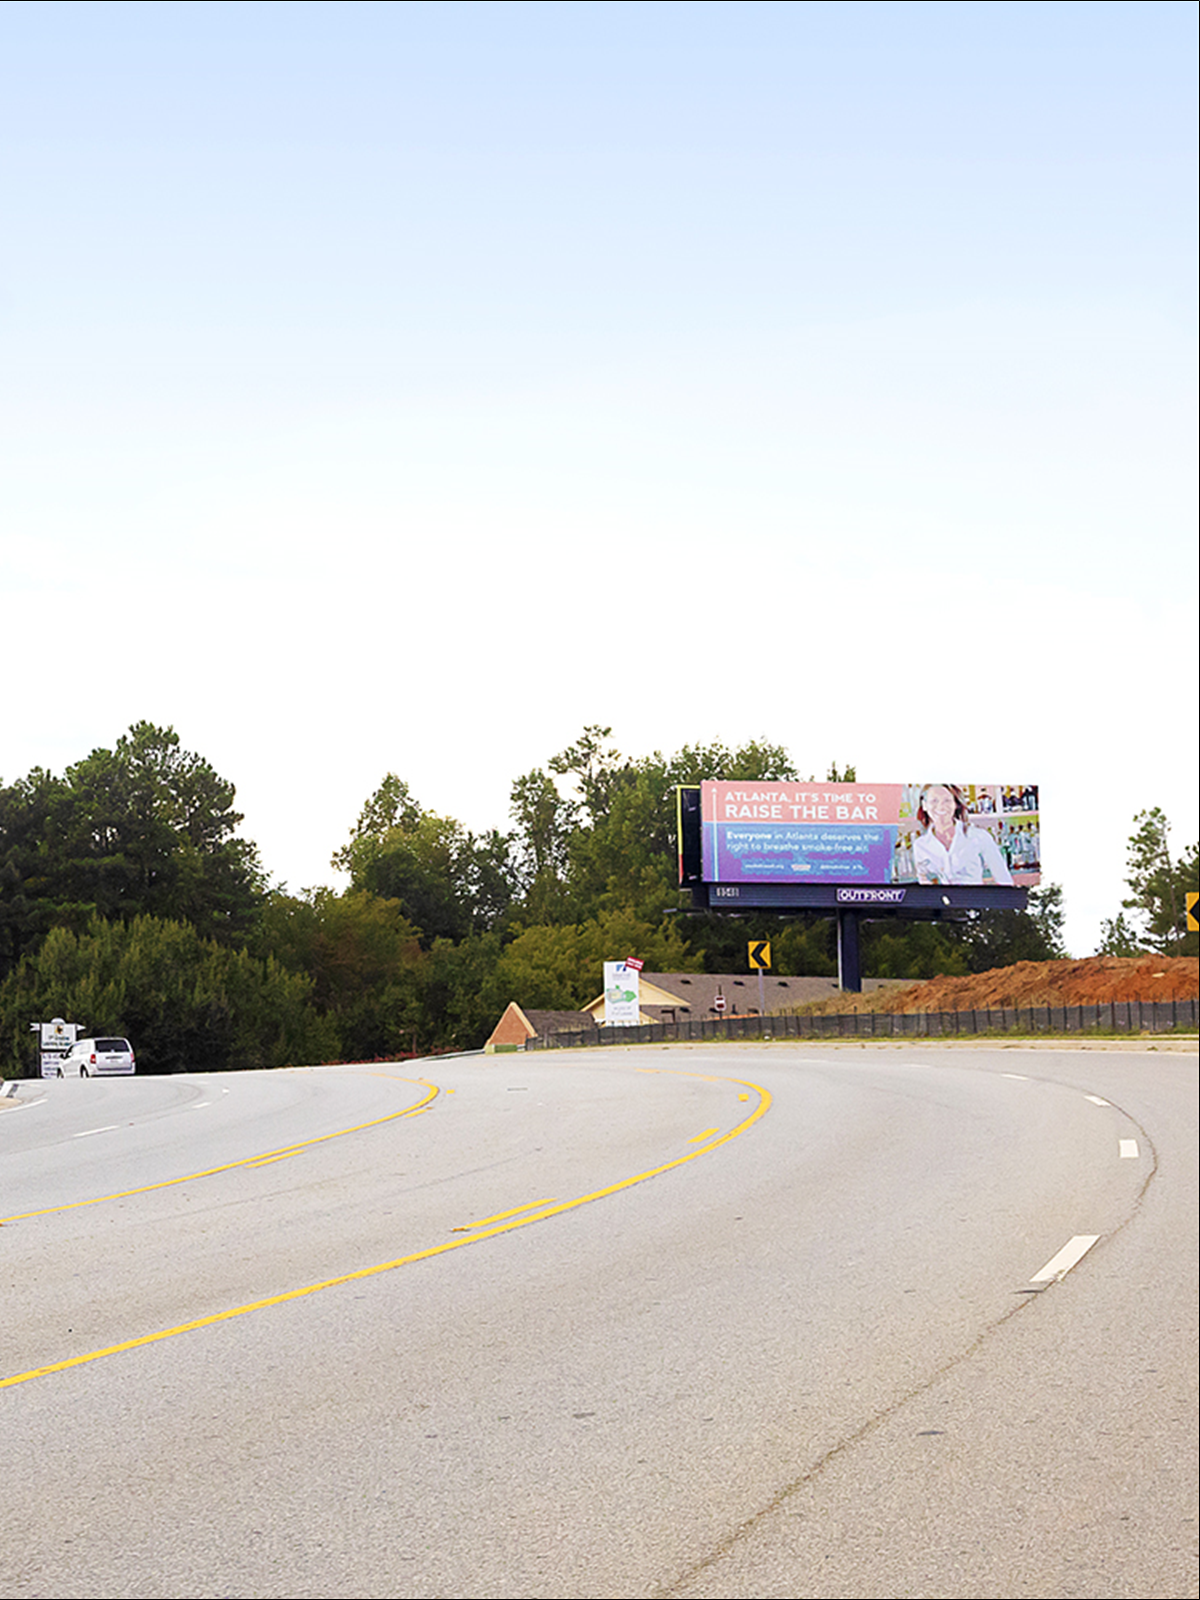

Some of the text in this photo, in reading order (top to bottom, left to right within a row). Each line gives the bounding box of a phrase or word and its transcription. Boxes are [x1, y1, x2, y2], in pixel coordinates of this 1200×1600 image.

[795, 792, 819, 803] IT'S
[822, 793, 853, 803] TIME
[857, 793, 876, 804] TO
[725, 804, 879, 820] RAISE THE BAR
[726, 831, 880, 842] Everyone in Atlanta deserves the
[726, 841, 749, 852] right
[751, 842, 762, 851] to
[763, 842, 799, 851] breathe
[840, 889, 903, 901] OUTFRONT
